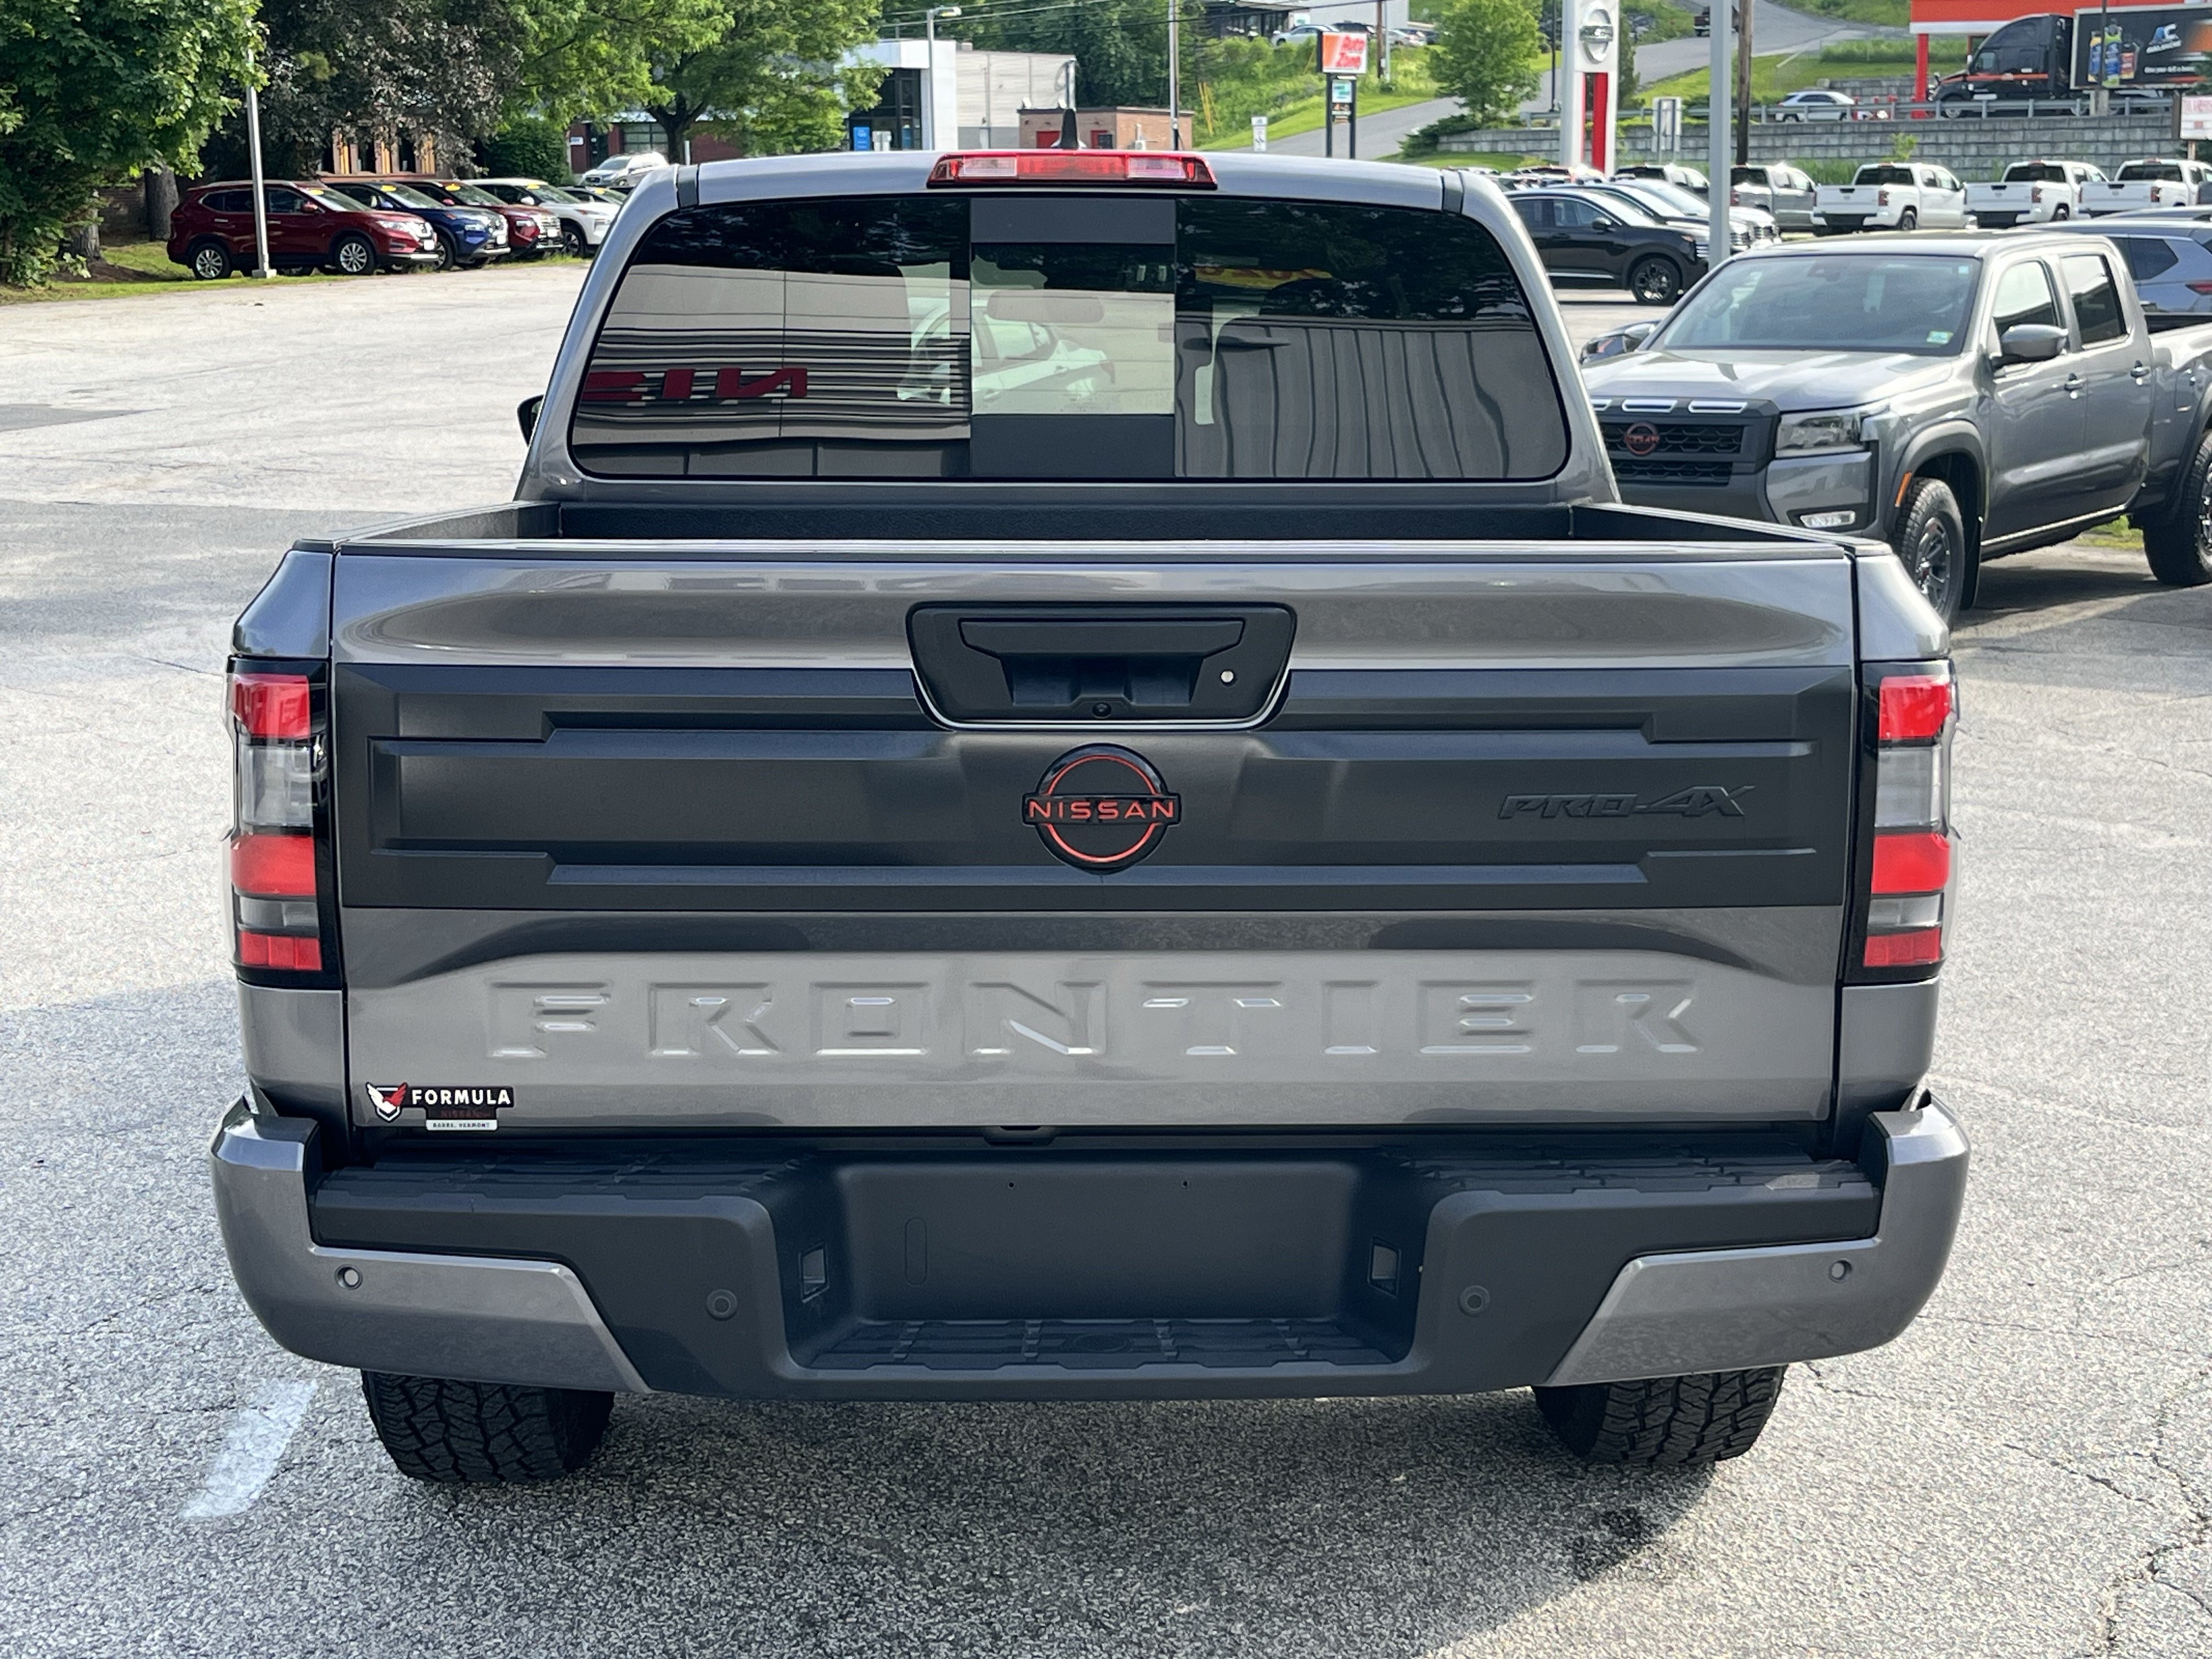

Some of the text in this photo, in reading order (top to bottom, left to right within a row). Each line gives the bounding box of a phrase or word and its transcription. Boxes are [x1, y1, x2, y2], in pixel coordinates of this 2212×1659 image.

[1028, 800, 1175, 819] NISSAN
[1498, 786, 1756, 819] PRO-4X
[486, 981, 1700, 1057] FRONTIER
[411, 1089, 511, 1105] FORMULA
